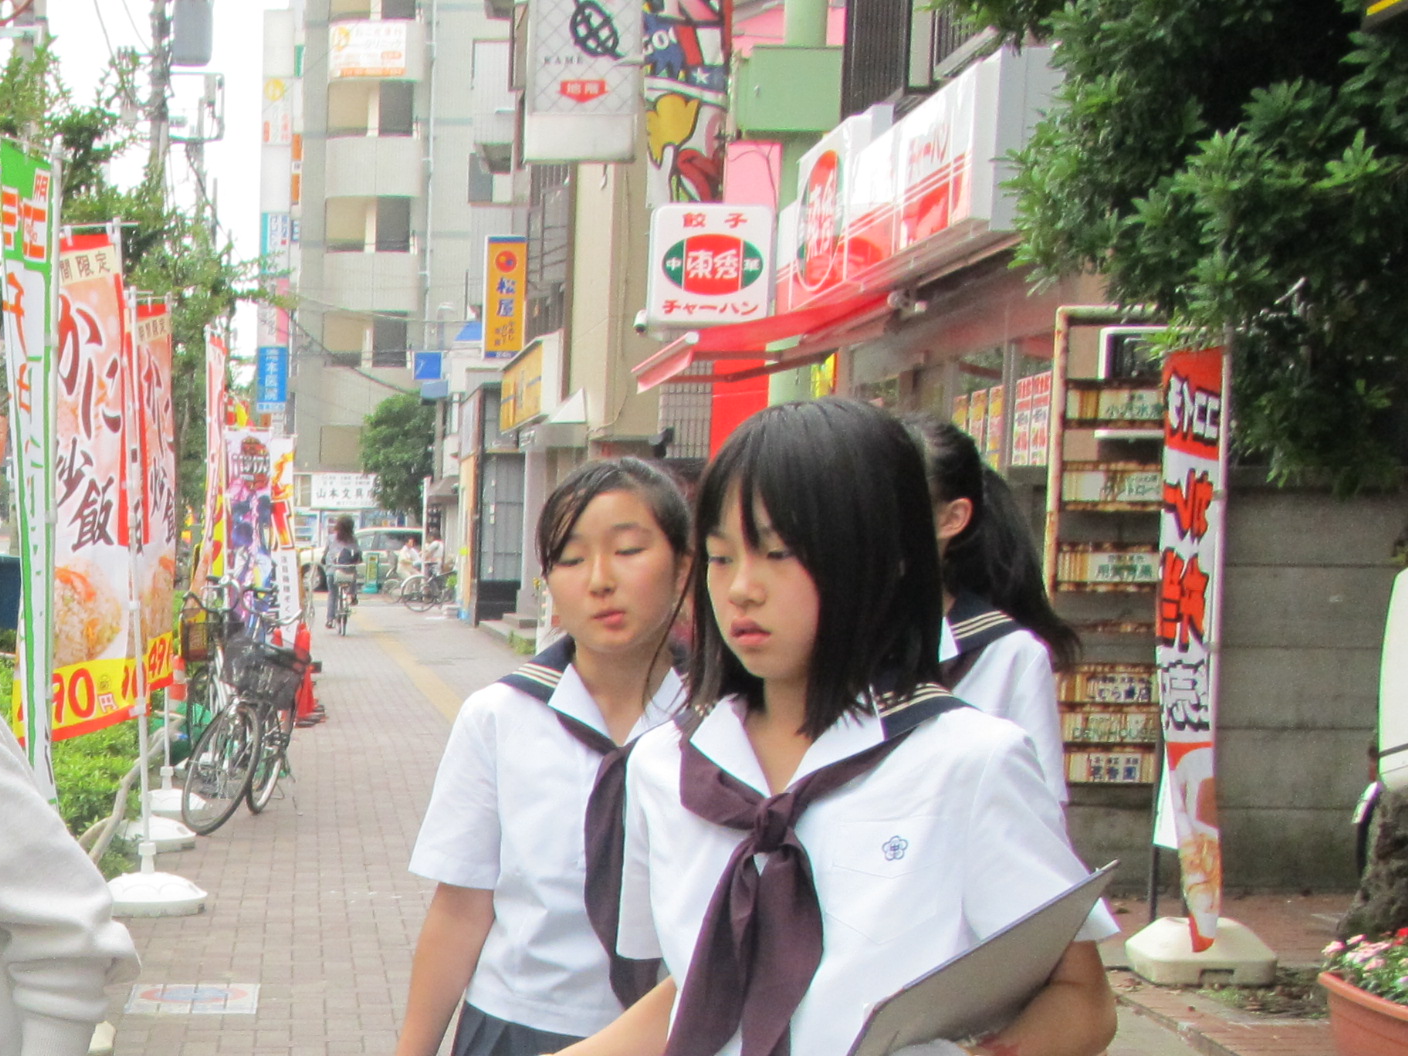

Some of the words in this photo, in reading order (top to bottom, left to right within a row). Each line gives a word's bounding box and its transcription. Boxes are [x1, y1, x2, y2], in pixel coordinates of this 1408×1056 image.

[682, 212, 748, 229] 餃子
[496, 276, 516, 317] 松屋
[662, 299, 760, 316] チャーハン
